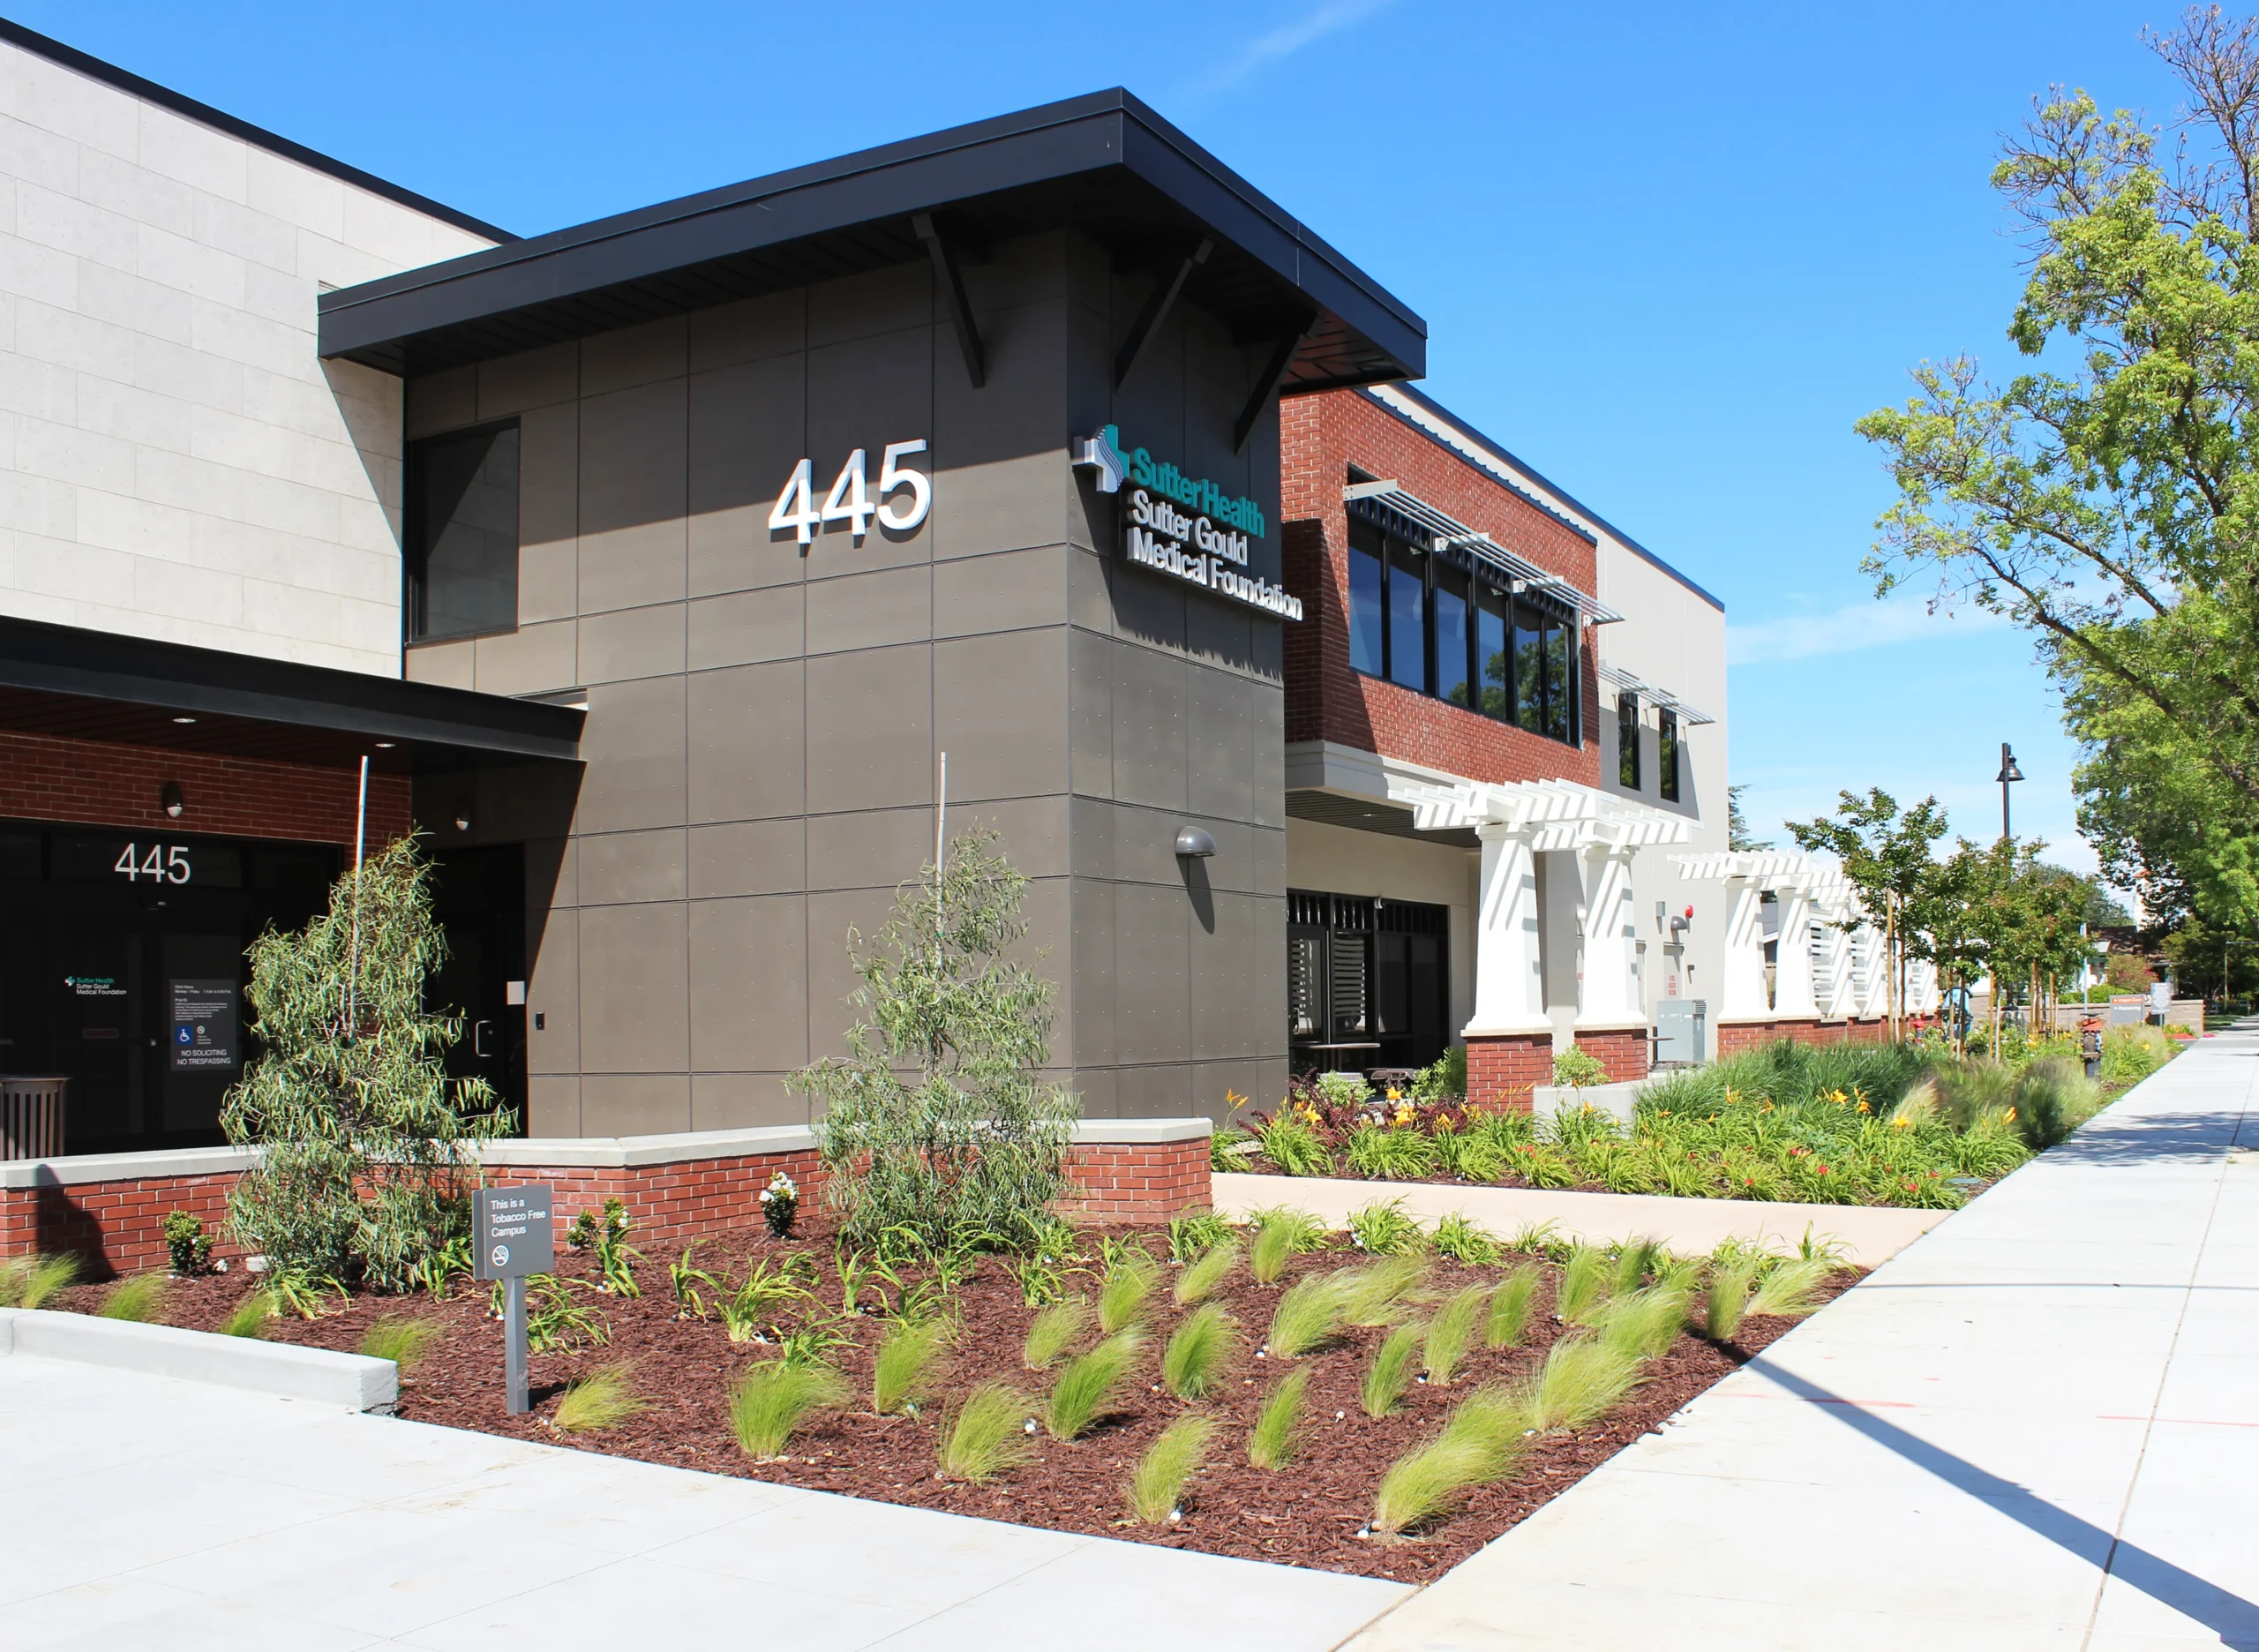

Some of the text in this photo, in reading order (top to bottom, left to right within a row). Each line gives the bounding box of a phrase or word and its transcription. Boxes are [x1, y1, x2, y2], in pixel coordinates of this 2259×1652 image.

[769, 439, 932, 544] 445
[1132, 447, 1265, 538] Sutter Health
[1128, 490, 1248, 566] Sutter Gould
[1127, 527, 1302, 620] Medical Foundation
[114, 843, 191, 884] 445
[491, 1198, 525, 1210] This is a
[491, 1209, 546, 1224] Tobacco Free
[491, 1226, 527, 1237] Campus
